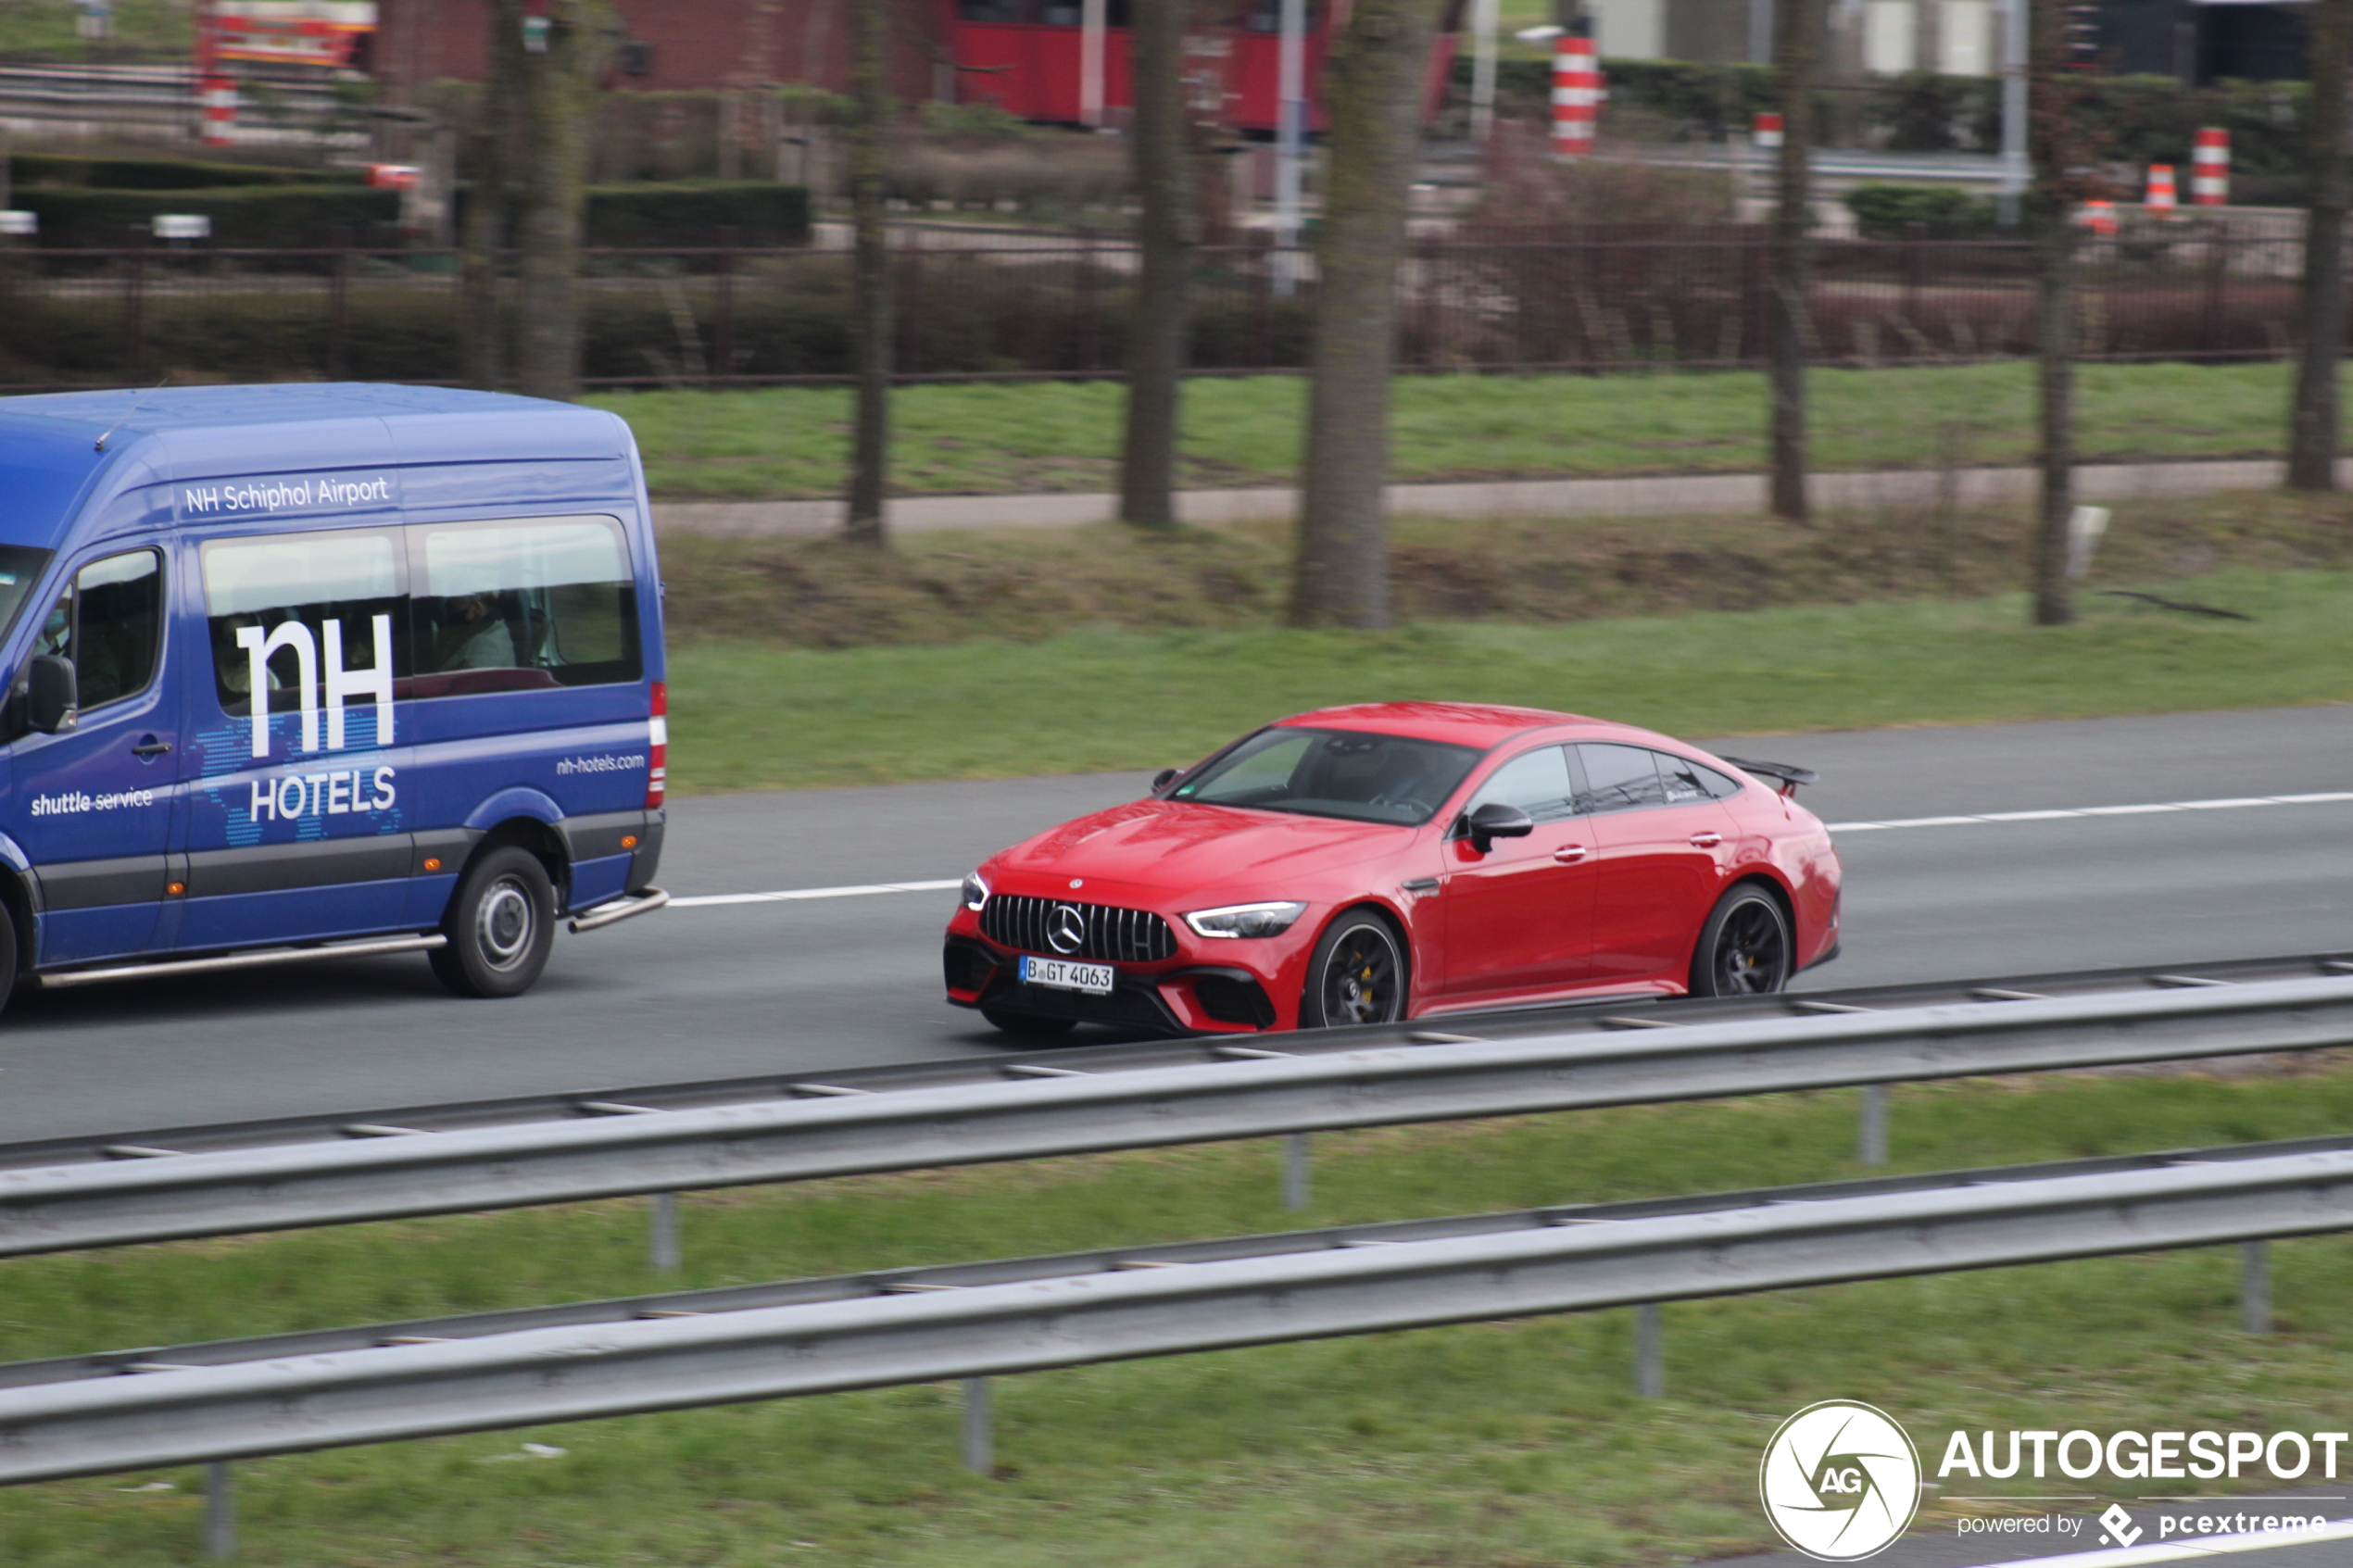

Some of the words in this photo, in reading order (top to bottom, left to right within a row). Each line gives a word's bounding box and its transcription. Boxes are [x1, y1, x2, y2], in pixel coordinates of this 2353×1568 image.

[185, 487, 220, 513] NH
[224, 480, 312, 512] Schiphol
[318, 476, 389, 507] Airport
[556, 754, 645, 776] nh-hotels.com
[31, 790, 91, 816] shuttle
[94, 786, 153, 811] service
[250, 766, 396, 822] HOTELS
[1027, 960, 1037, 978] B
[1047, 962, 1066, 982] GT
[1070, 966, 1111, 987] 4063
